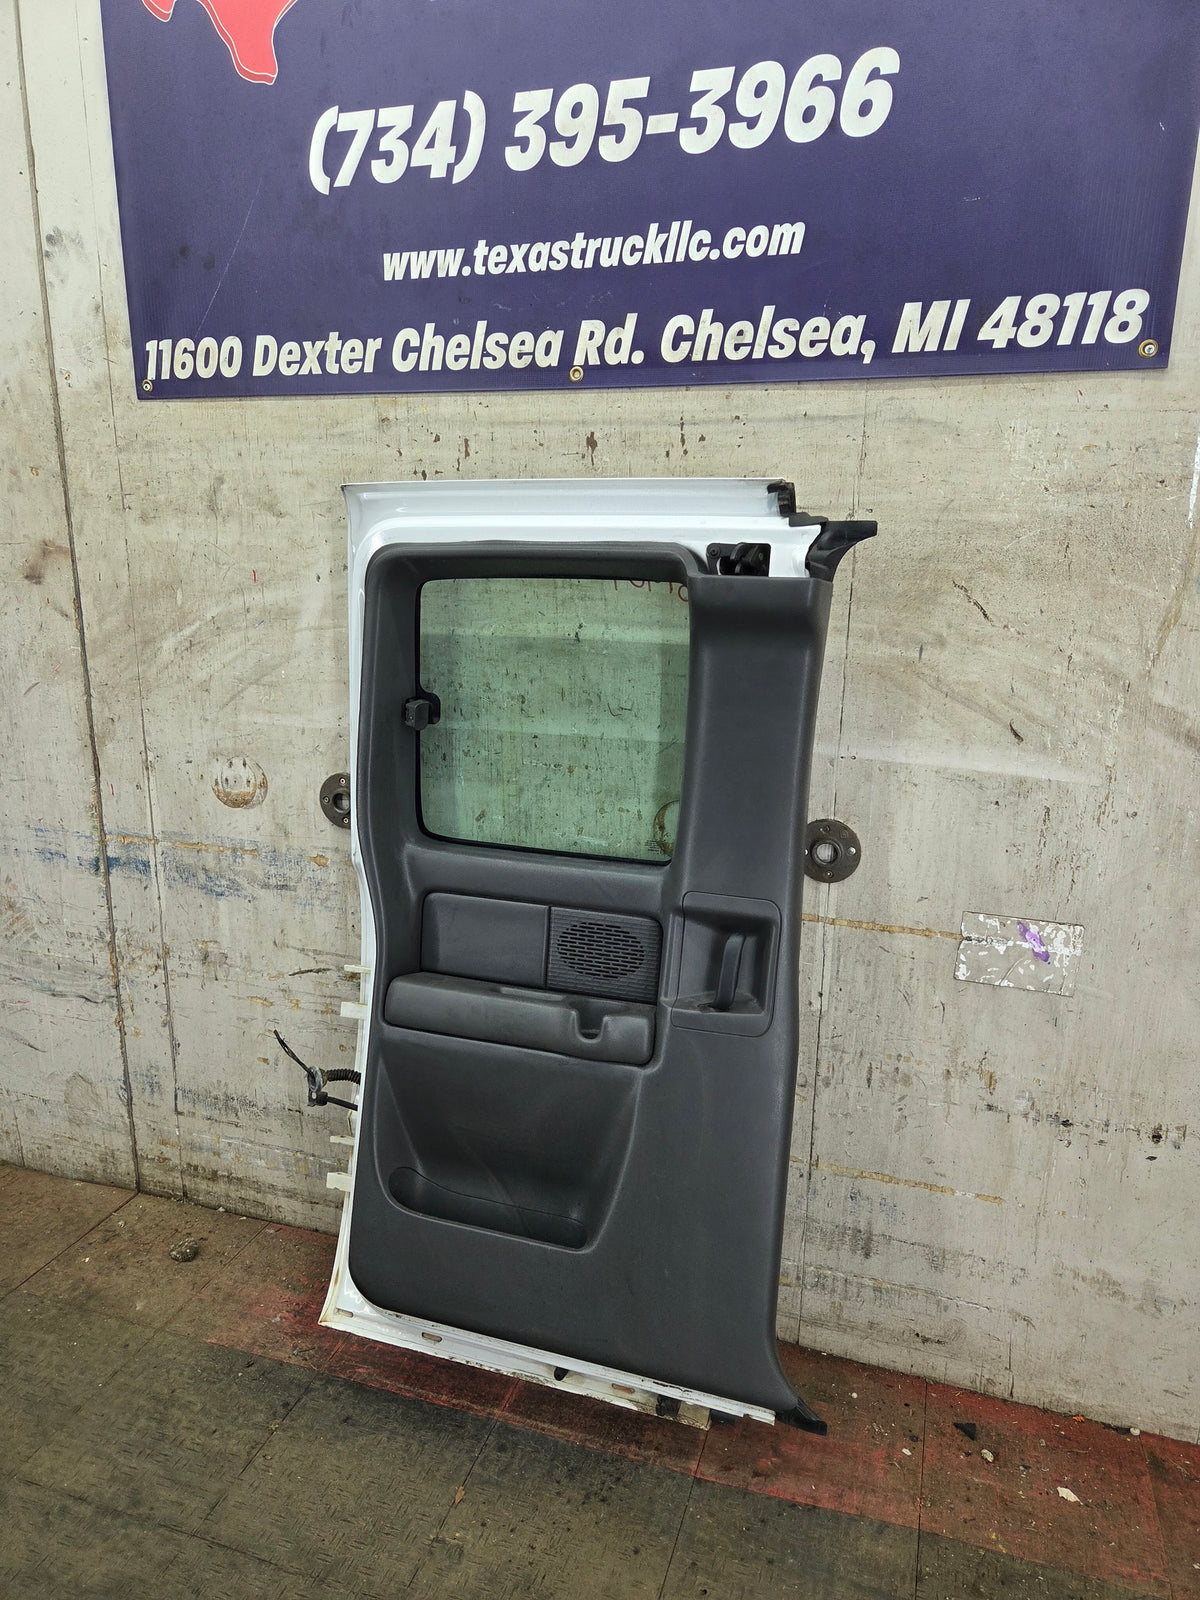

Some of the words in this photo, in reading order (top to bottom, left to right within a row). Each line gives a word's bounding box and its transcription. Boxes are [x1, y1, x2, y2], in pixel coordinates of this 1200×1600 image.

[309, 90, 486, 195] (734)
[504, 46, 900, 172] 395-3966
[382, 219, 806, 281] www.texastruckllc.com
[145, 336, 242, 380] 11600
[252, 332, 382, 376] Dexter
[391, 320, 564, 371] Chelsea
[574, 313, 644, 366] Rd.
[660, 305, 876, 364] Chelsea,
[891, 299, 971, 354] MI
[977, 288, 1150, 349] 48118
